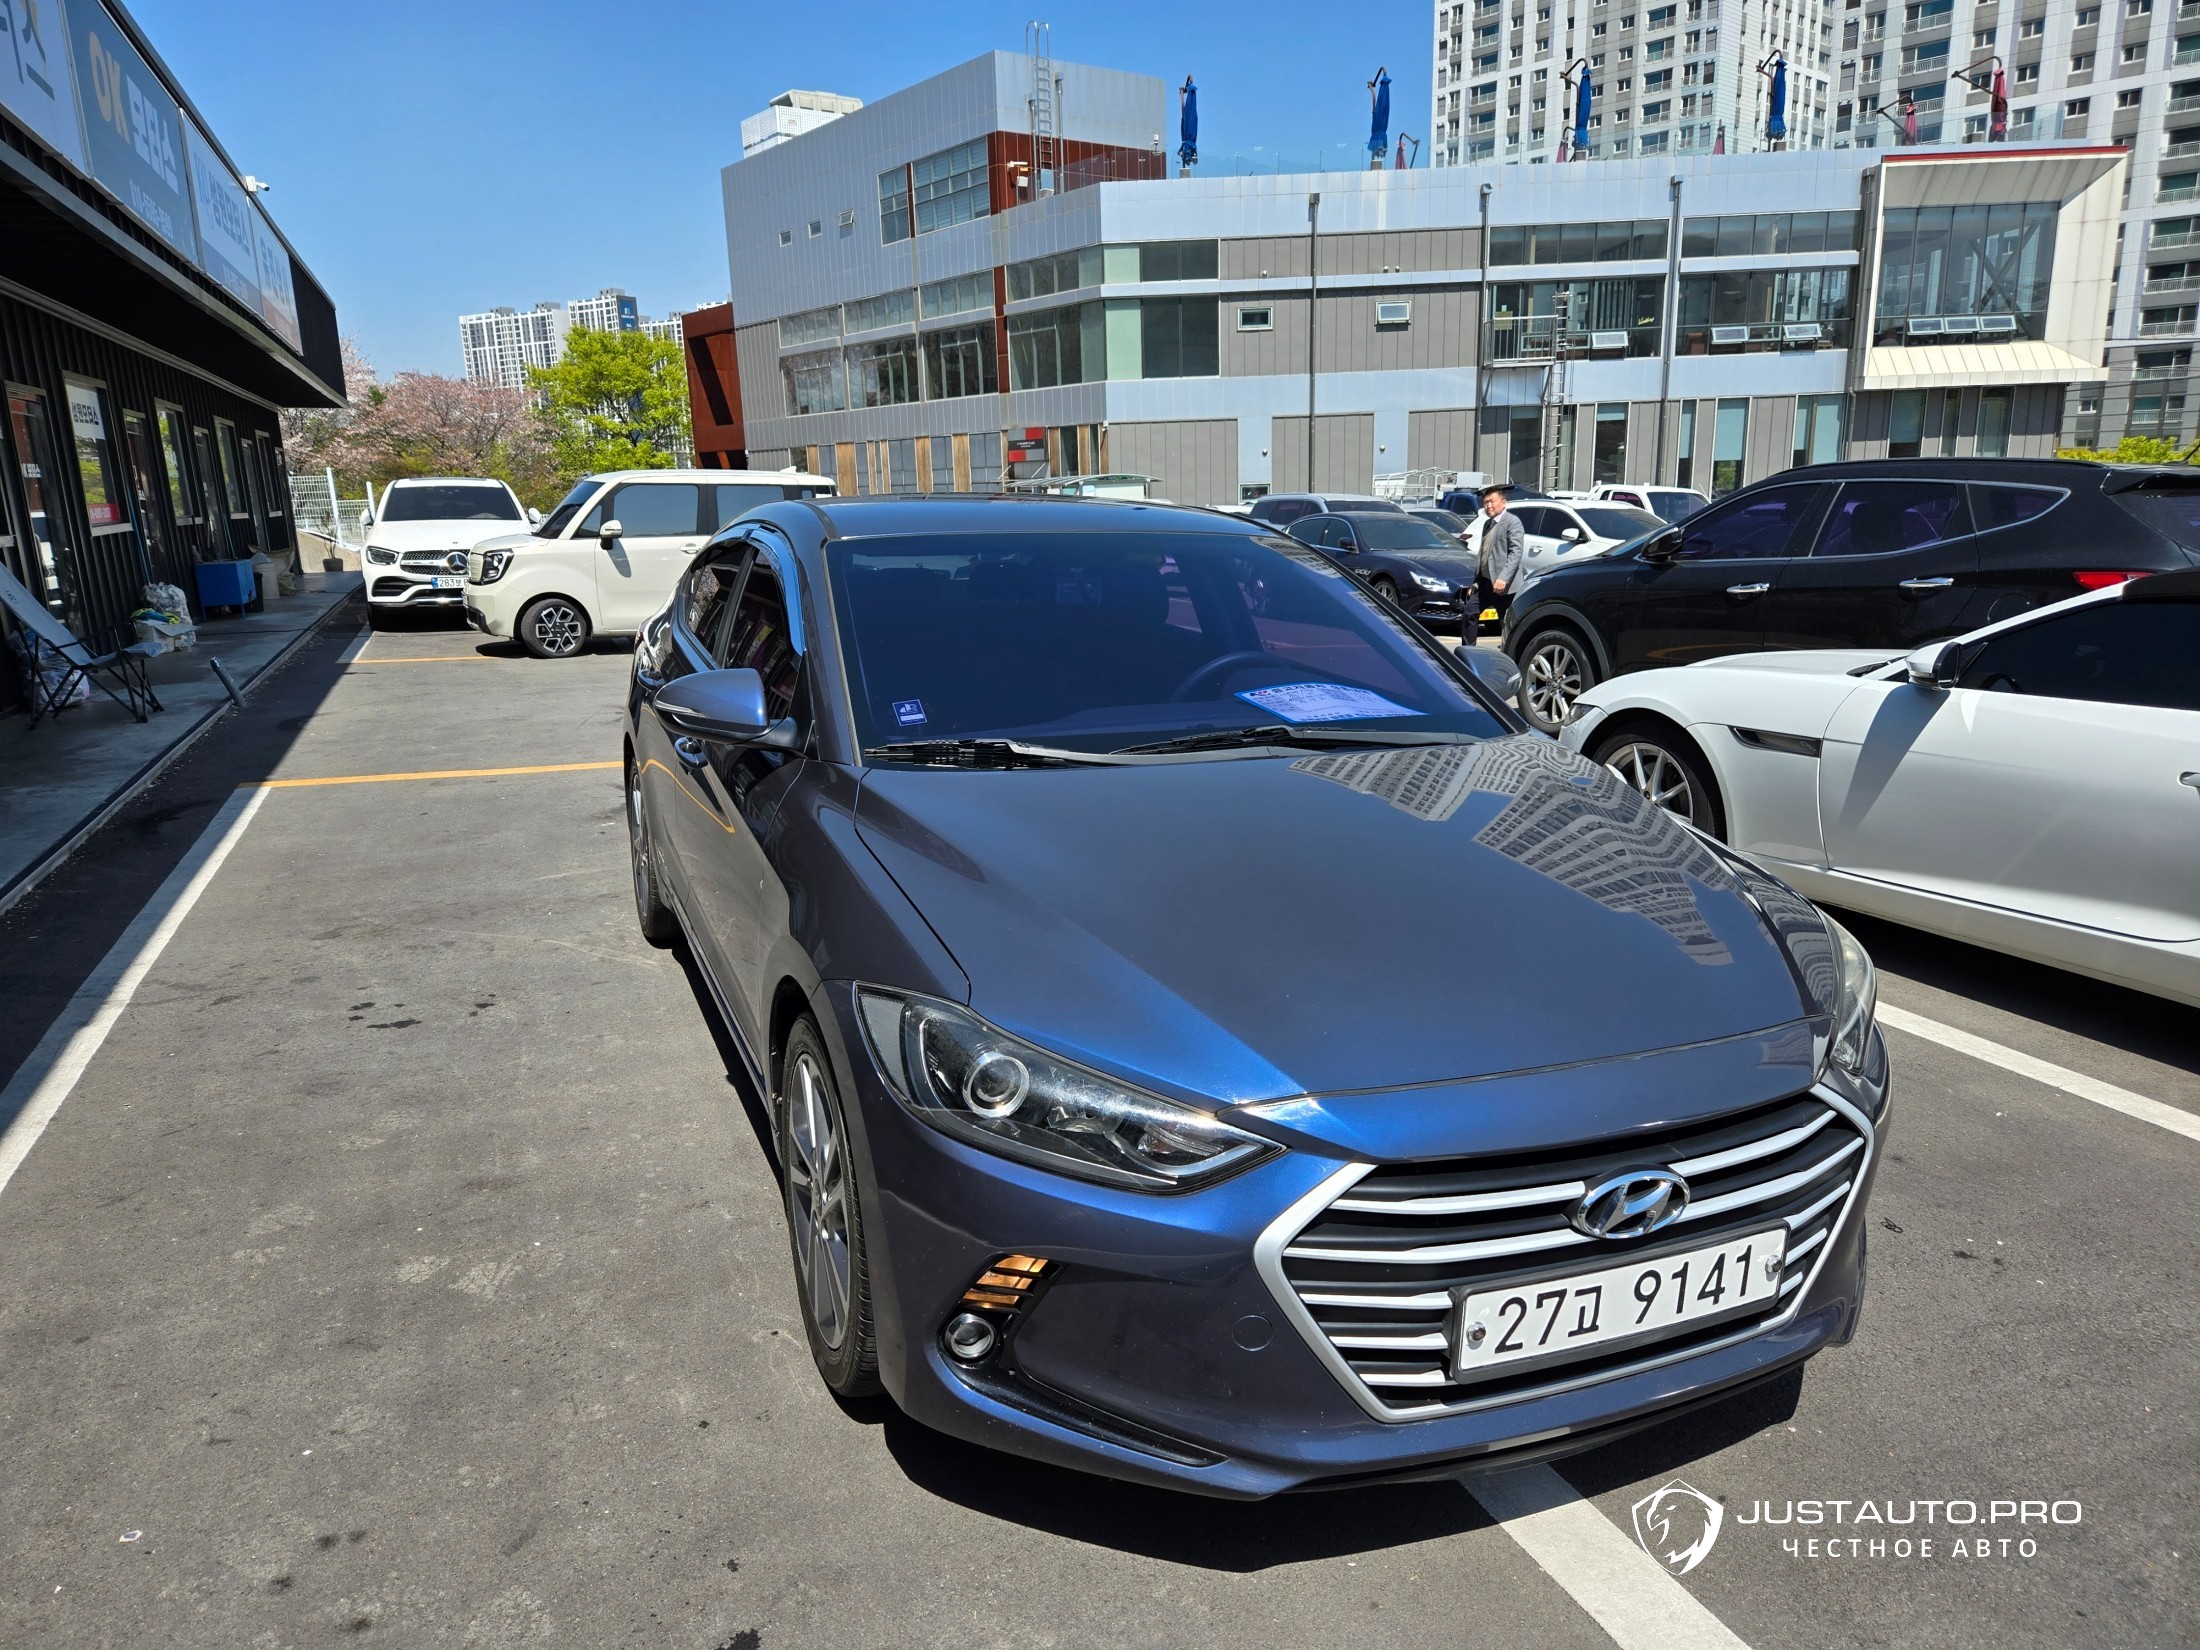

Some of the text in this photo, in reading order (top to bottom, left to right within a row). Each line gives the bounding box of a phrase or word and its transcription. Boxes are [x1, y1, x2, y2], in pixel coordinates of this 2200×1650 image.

[90, 31, 131, 145] OK
[126, 74, 179, 195] 모터스
[1494, 1244, 1753, 1354] 27고 9141
